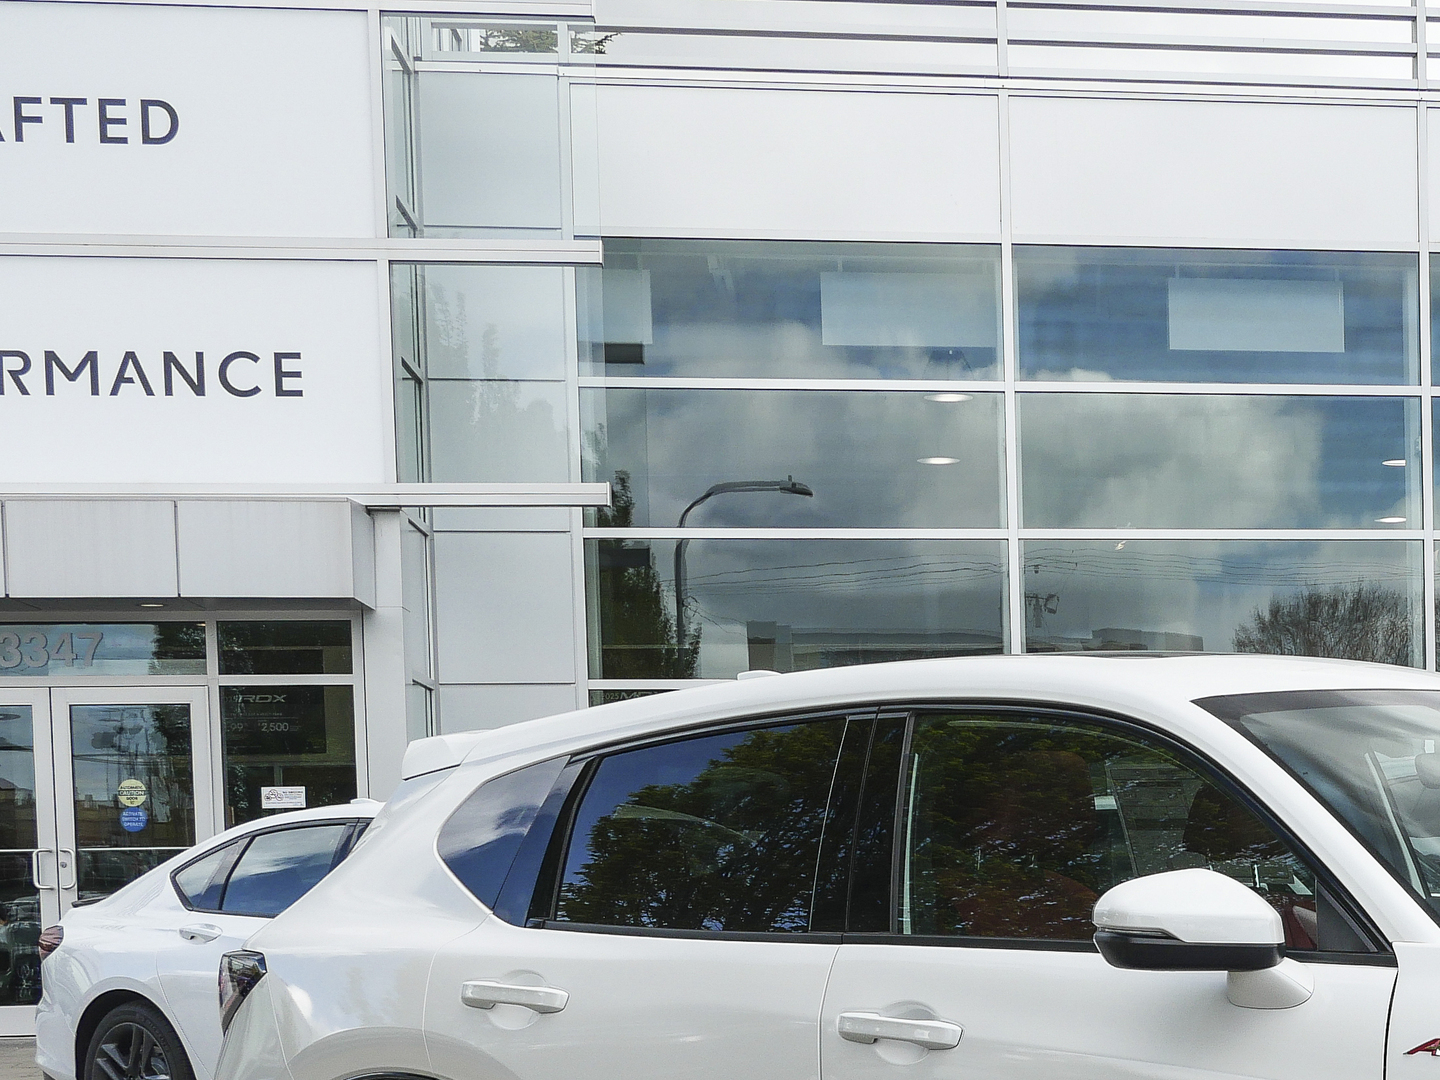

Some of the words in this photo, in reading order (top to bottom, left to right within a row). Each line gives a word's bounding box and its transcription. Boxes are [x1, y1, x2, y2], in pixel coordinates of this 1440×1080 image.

[0, 96, 180, 145] FTED
[0, 349, 304, 398] RMANCE
[0, 632, 104, 668] 3347
[239, 694, 287, 703] RDX
